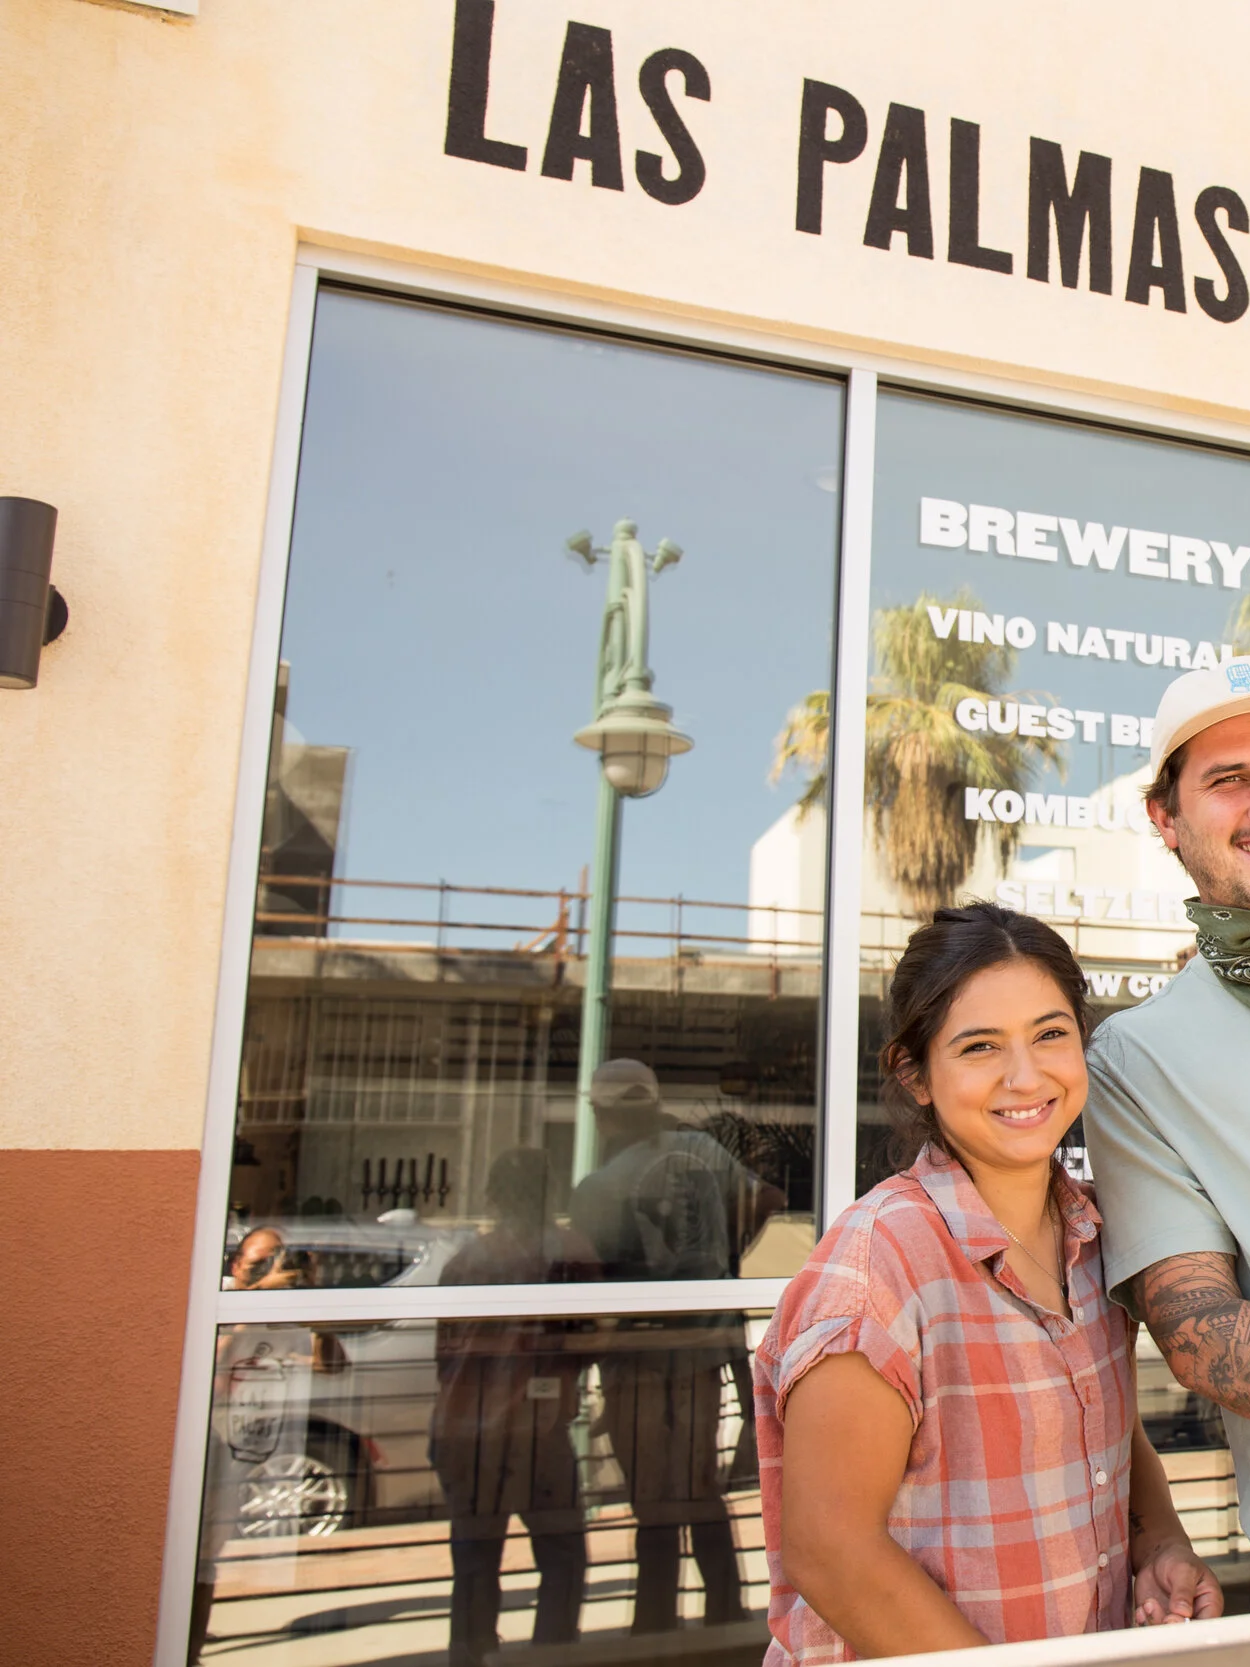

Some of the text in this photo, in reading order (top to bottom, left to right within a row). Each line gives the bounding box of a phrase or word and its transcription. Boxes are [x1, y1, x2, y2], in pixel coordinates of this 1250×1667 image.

[444, 0, 1250, 324] LAS PALMAS
[927, 606, 1036, 649] VINO
[956, 697, 1105, 743] GUEST
[965, 787, 1150, 832] KOMBUC
[996, 881, 1184, 923] SELTZER
